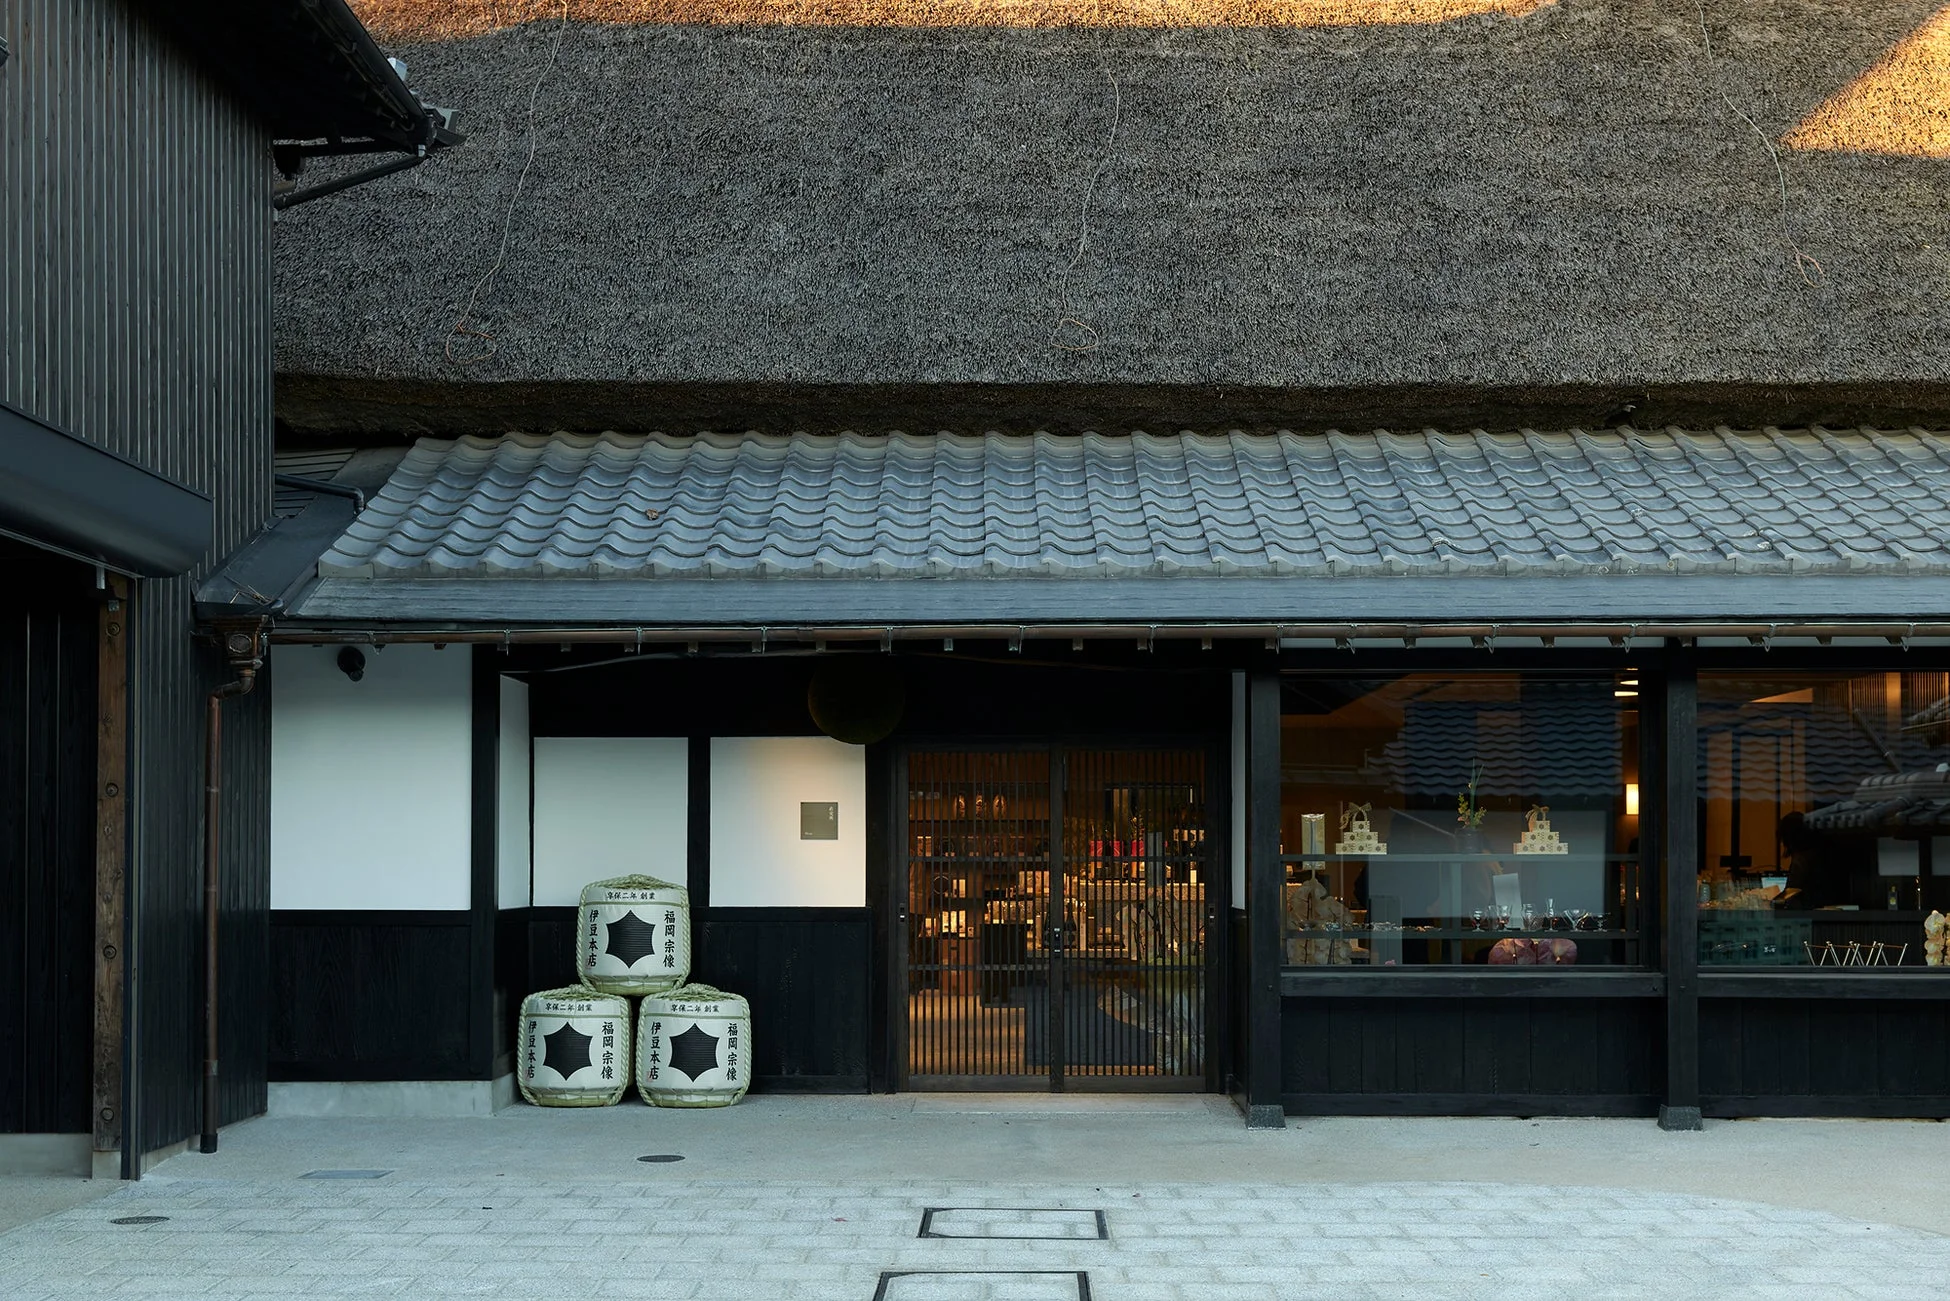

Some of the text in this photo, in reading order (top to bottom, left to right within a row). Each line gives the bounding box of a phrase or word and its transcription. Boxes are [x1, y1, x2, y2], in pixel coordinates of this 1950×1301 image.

[587, 909, 599, 967] 伊豆本店
[662, 910, 676, 968] 福岡宗像
[527, 1021, 537, 1079] 伊豆本店
[601, 1021, 614, 1080] 福岡宗像
[649, 1021, 662, 1080] 伊豆本店
[726, 1022, 739, 1081] 福岡宗像
